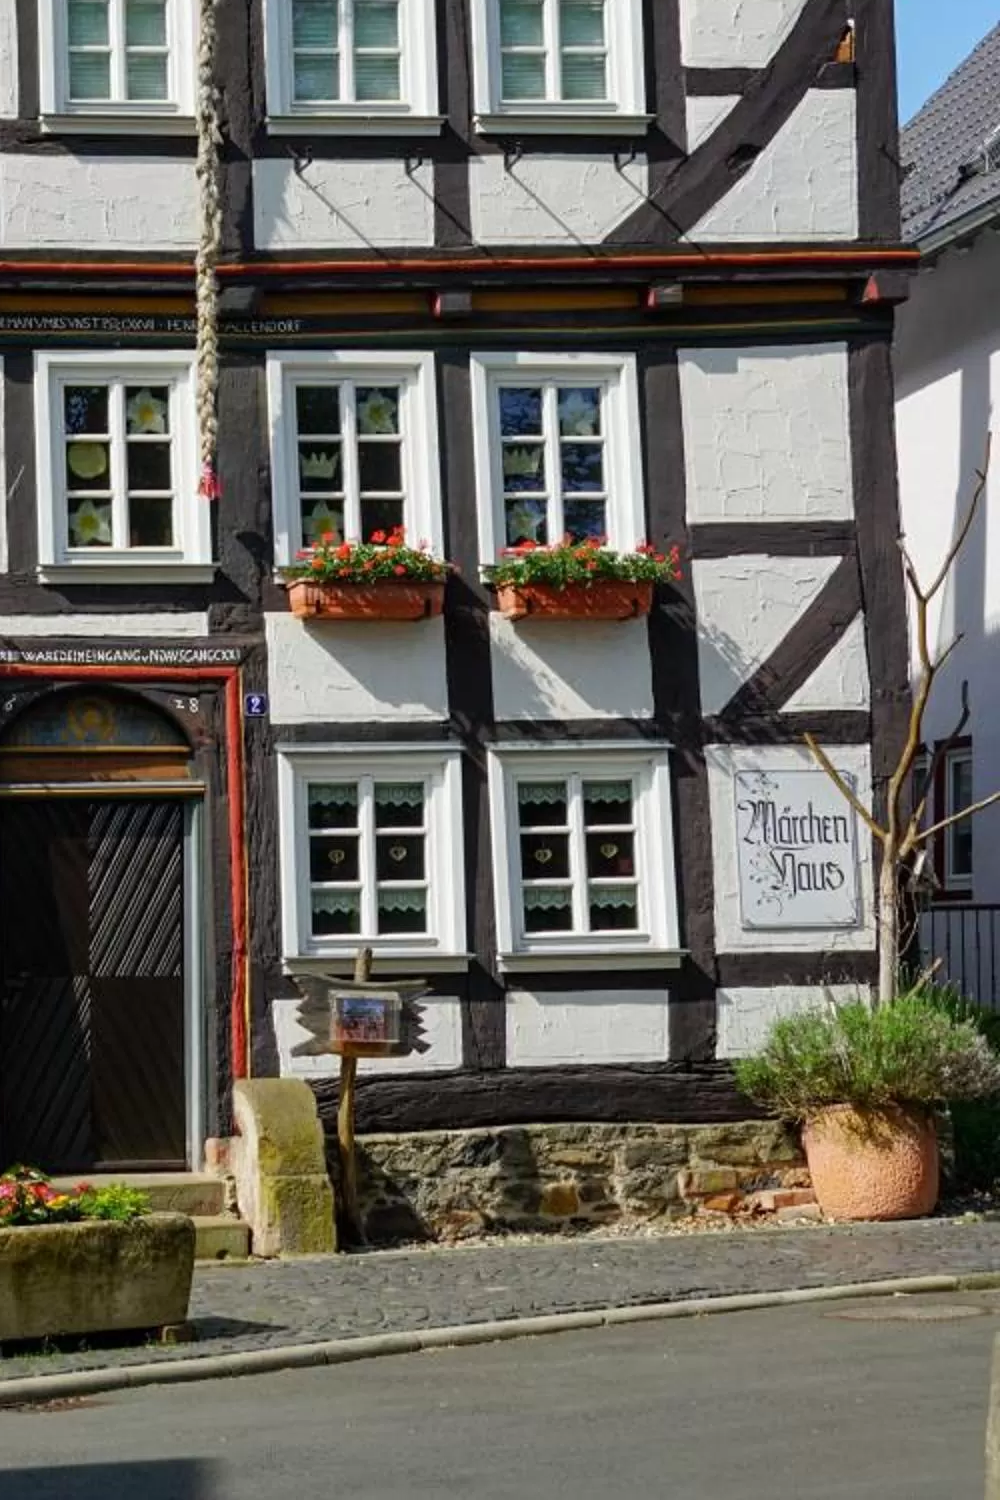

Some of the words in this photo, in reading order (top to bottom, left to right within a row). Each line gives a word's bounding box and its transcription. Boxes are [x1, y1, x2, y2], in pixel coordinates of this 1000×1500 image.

[251, 696, 260, 713] 2
[737, 799, 849, 846] Märchen
[770, 850, 845, 896] Haus
